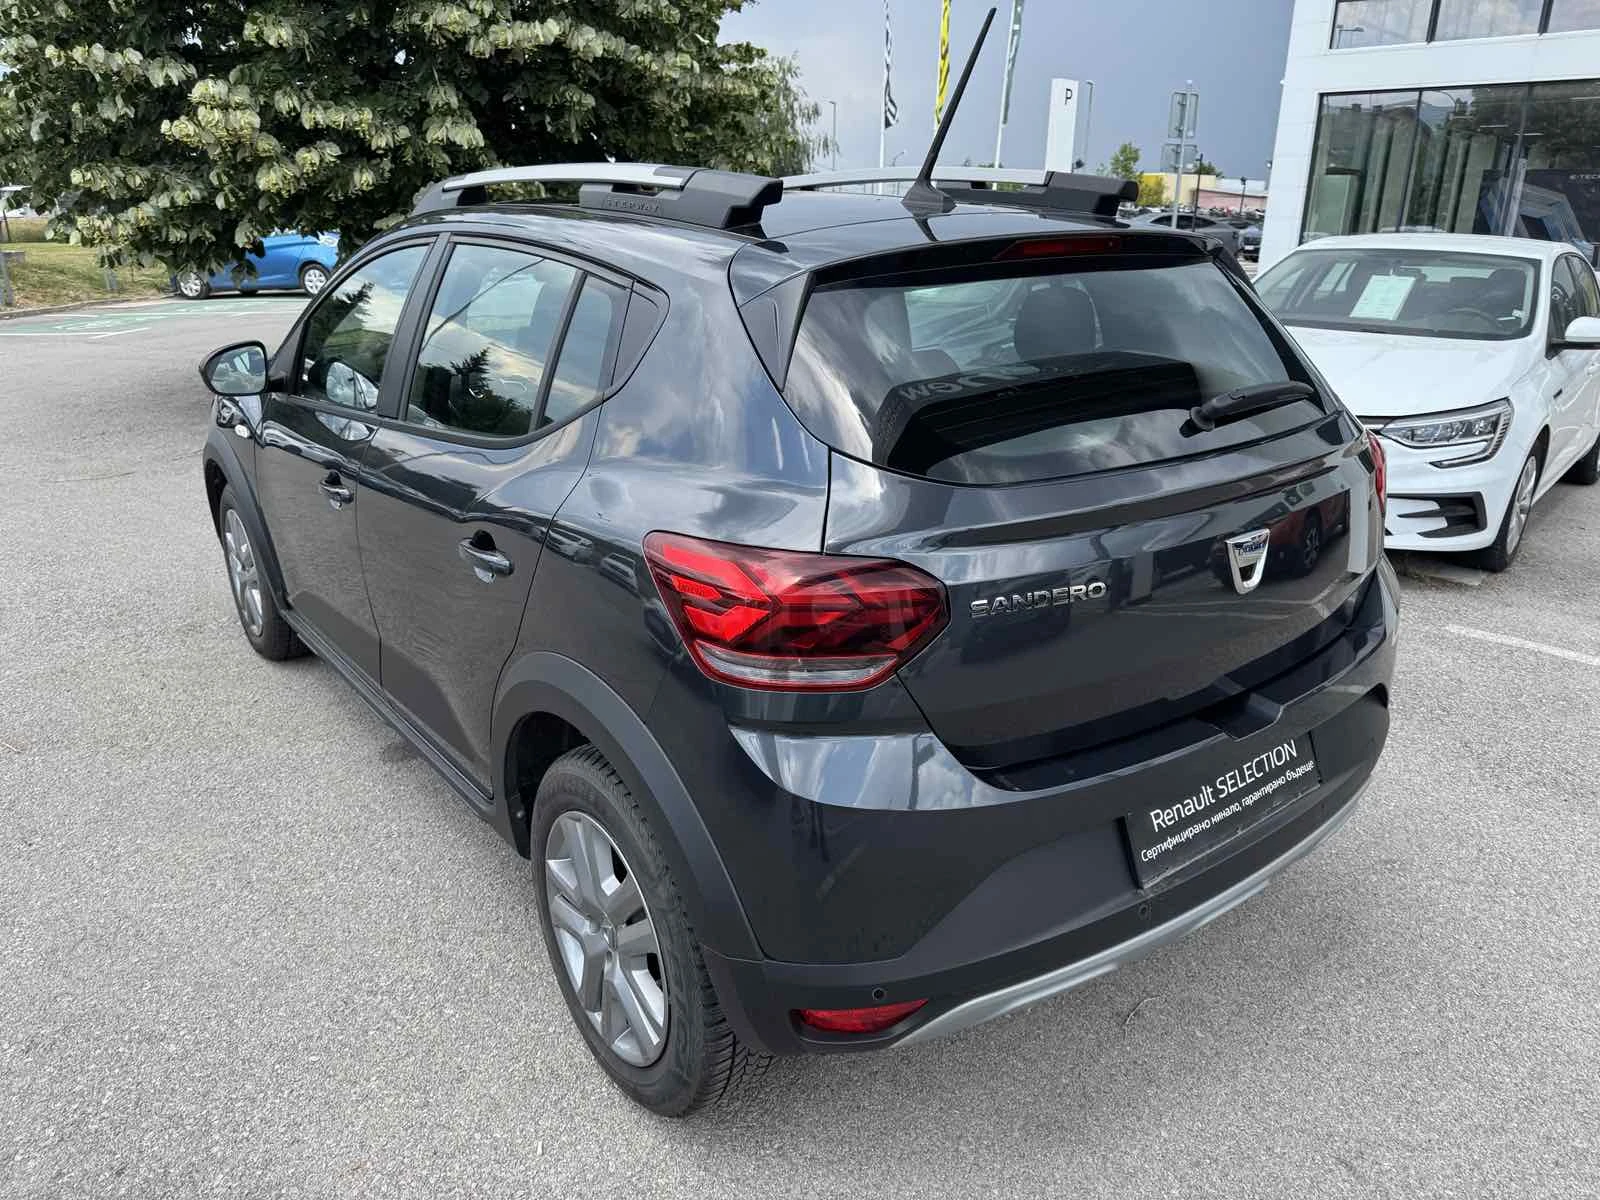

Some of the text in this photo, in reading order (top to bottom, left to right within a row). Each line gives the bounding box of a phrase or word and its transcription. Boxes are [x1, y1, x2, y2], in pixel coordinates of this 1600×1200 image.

[1065, 88, 1073, 105] P
[970, 581, 1107, 618] SANDERO
[1141, 819, 1211, 861] Сертифицирано
[1241, 776, 1286, 806] гарантирано
[1286, 760, 1314, 781] бъдеще
[1150, 739, 1297, 833] Renault SELECTION
